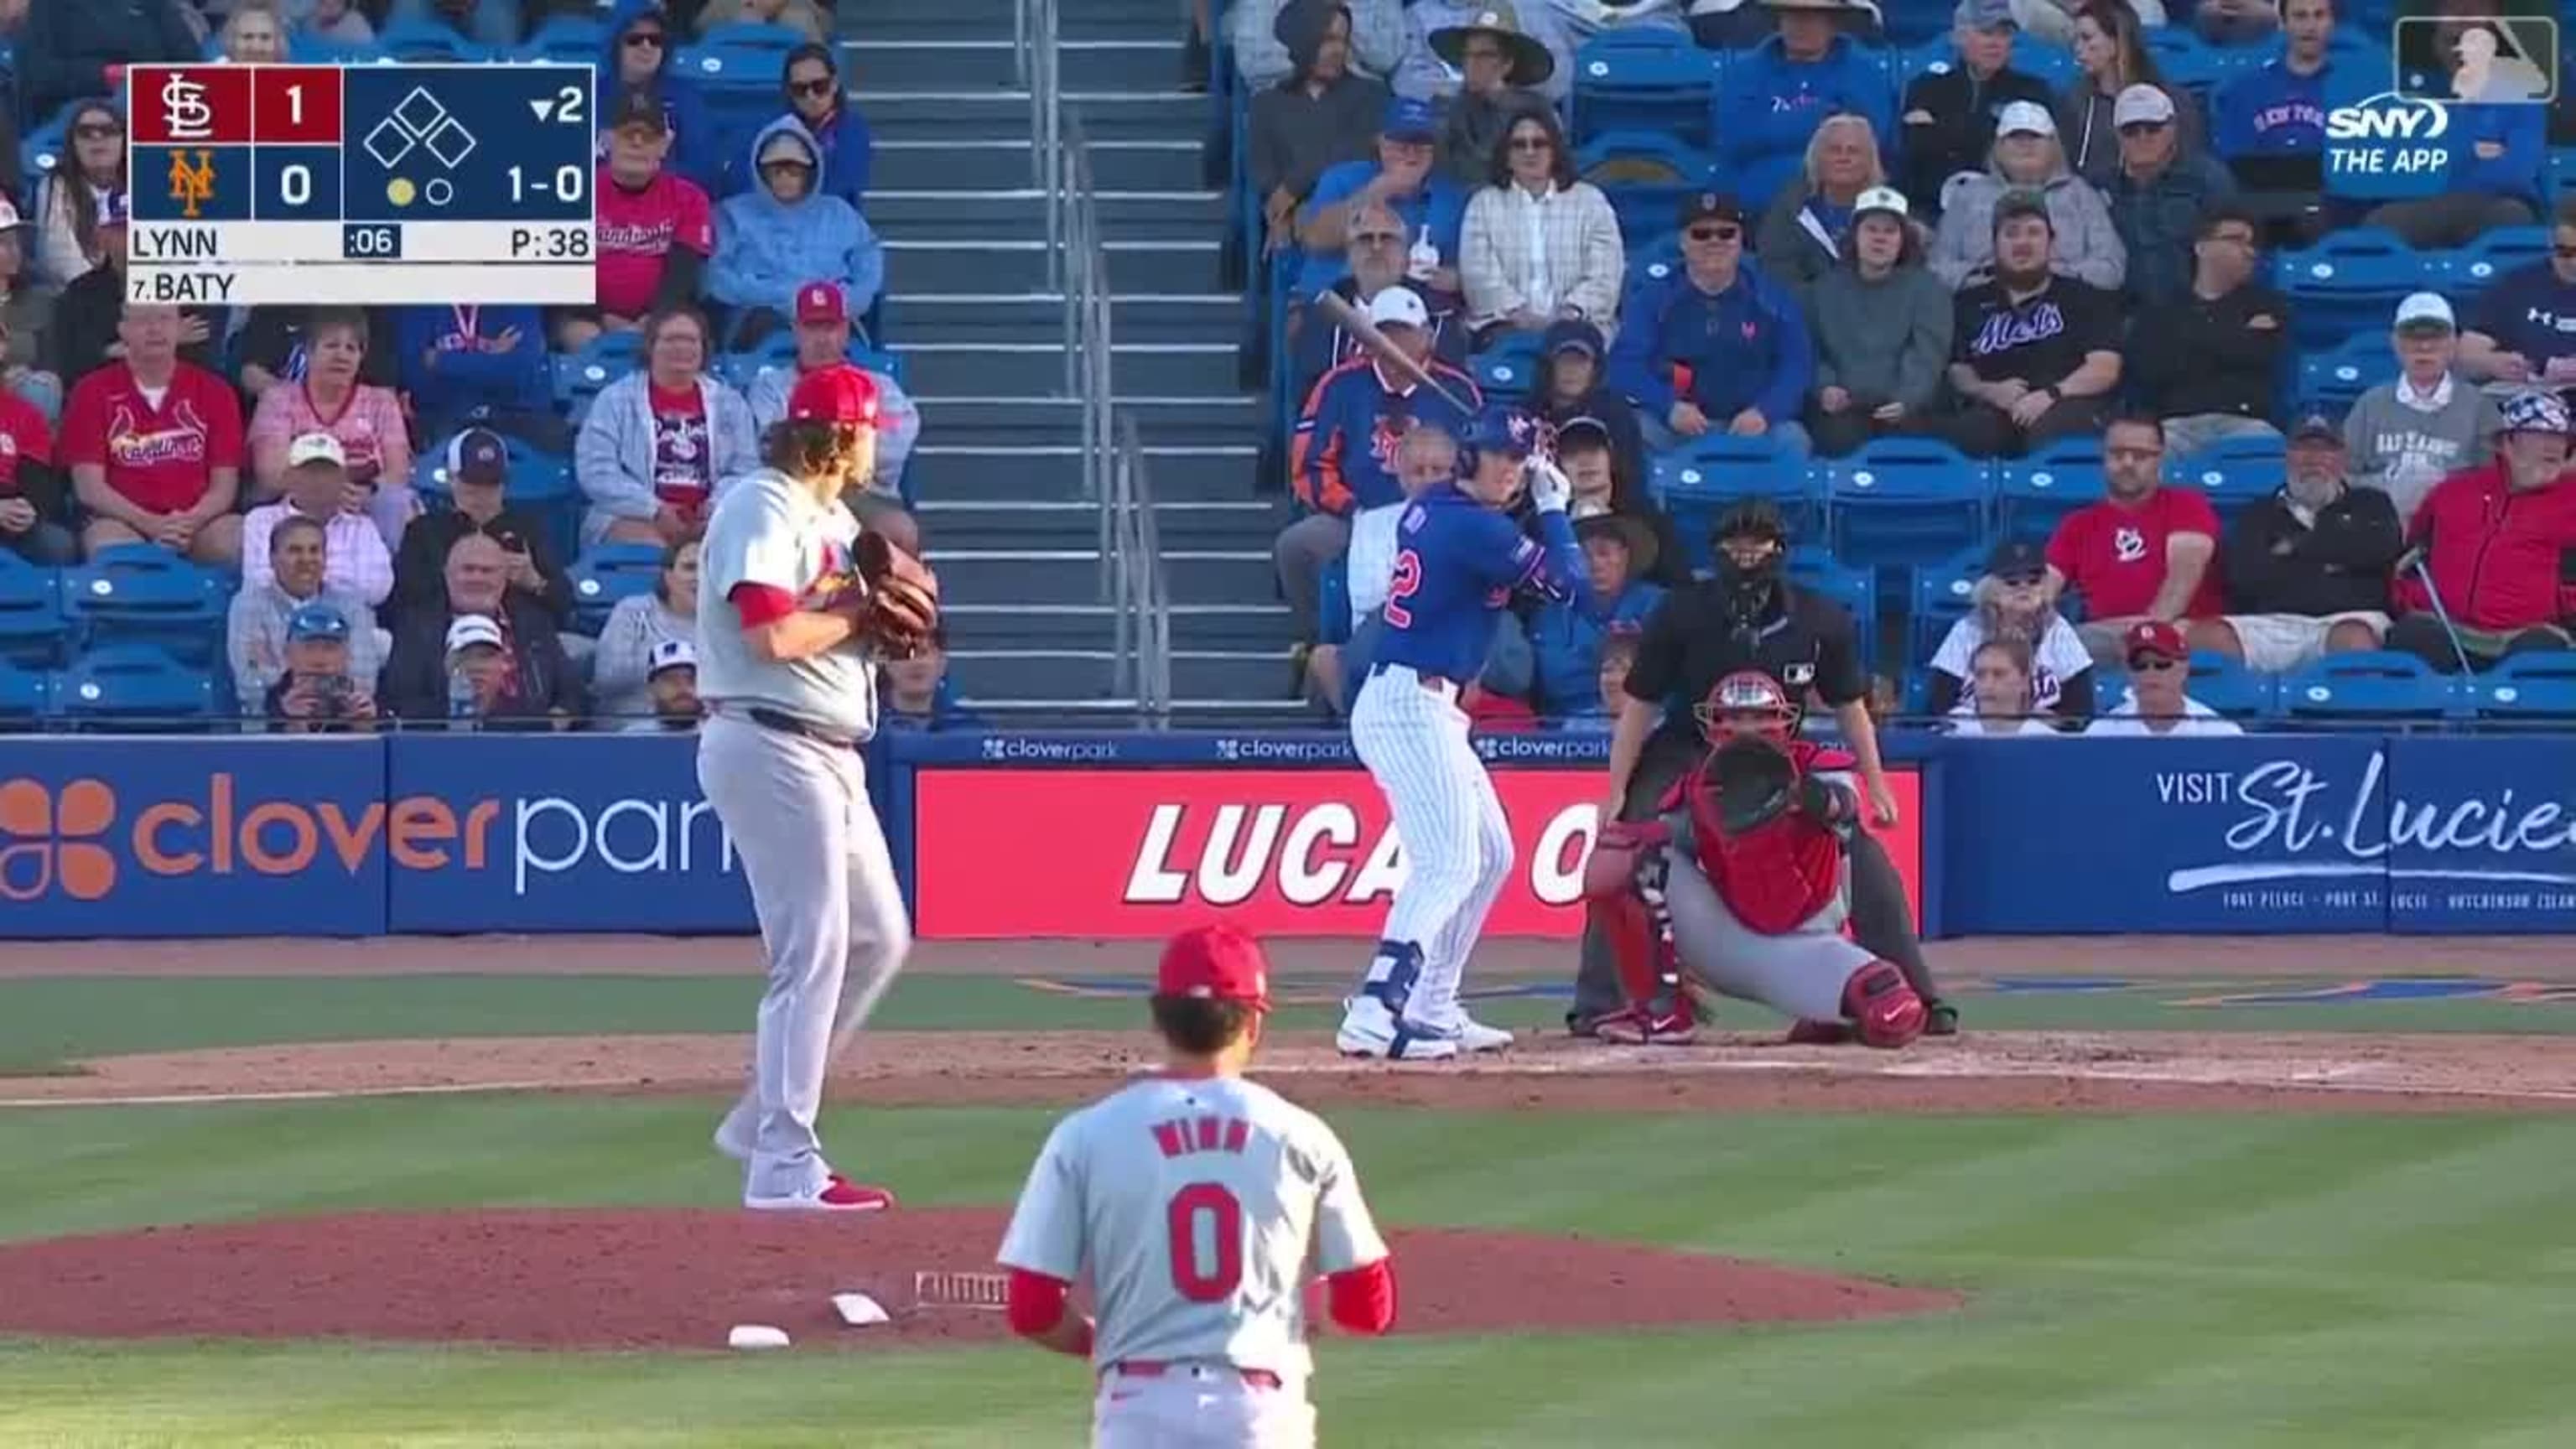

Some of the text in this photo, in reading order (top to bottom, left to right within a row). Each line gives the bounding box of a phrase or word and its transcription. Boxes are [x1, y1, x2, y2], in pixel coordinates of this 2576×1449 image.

[1971, 303, 2064, 354] Mets
[2156, 772, 2233, 804] VISIT
[1166, 1182, 1244, 1286] 0
